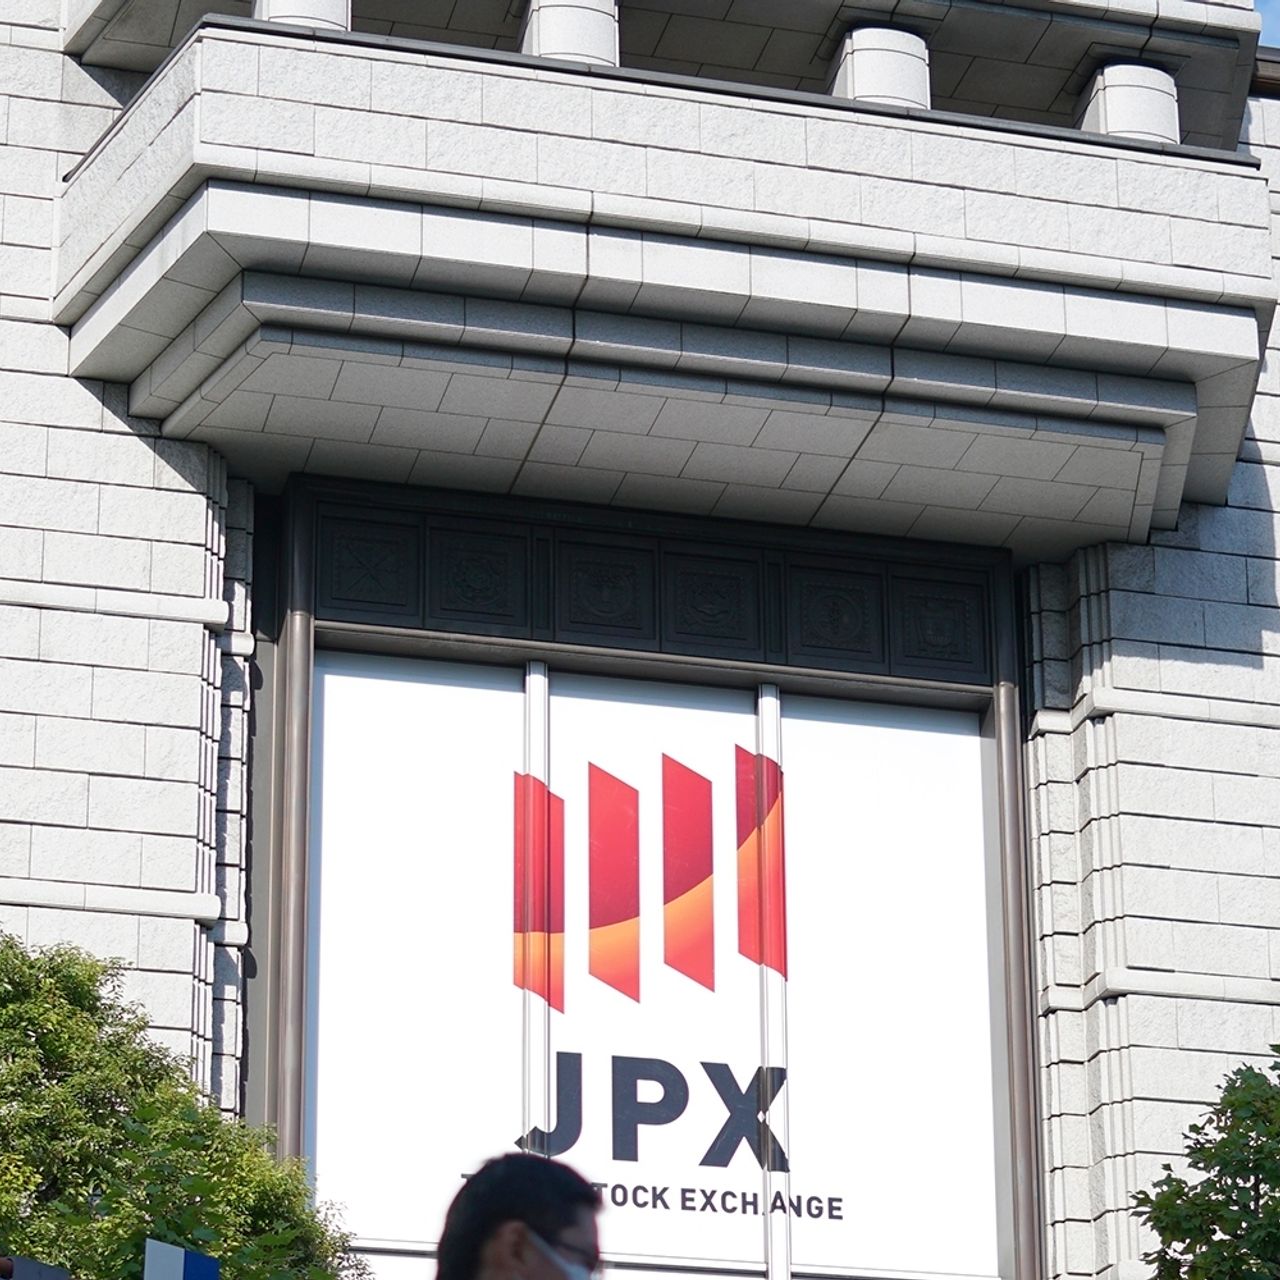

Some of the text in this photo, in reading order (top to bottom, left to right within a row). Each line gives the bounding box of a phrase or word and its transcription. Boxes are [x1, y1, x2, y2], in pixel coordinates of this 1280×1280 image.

[514, 1051, 790, 1173] JPX
[591, 1182, 844, 1220] TOCK EXCHANGE
